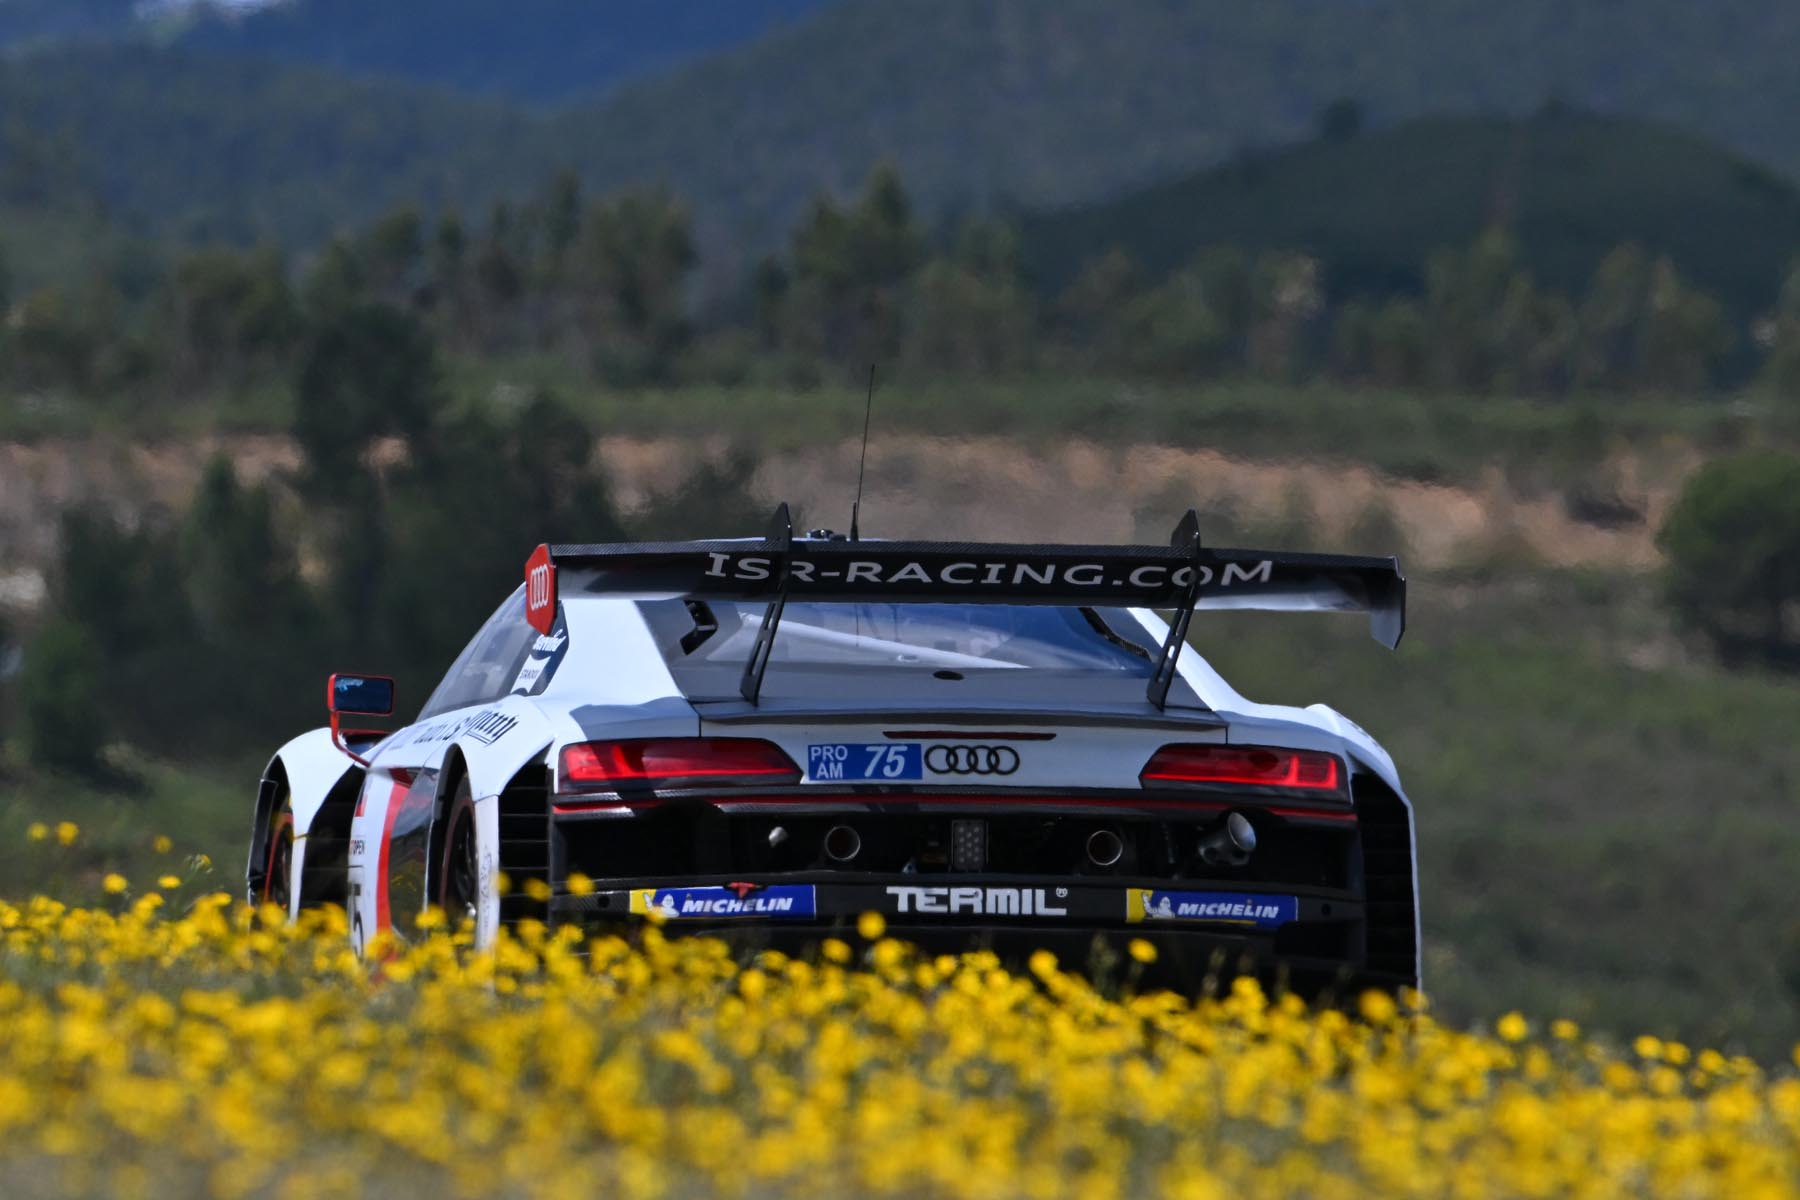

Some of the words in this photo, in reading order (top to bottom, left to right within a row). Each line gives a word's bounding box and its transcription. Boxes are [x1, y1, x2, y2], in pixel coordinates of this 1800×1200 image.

[705, 552, 1273, 588] ISR-RACING.COM
[810, 745, 848, 761] PRO
[816, 762, 844, 779] AM
[864, 746, 908, 778] 75
[681, 896, 793, 913] MICHELIN
[1177, 902, 1279, 918] MICHELIN
